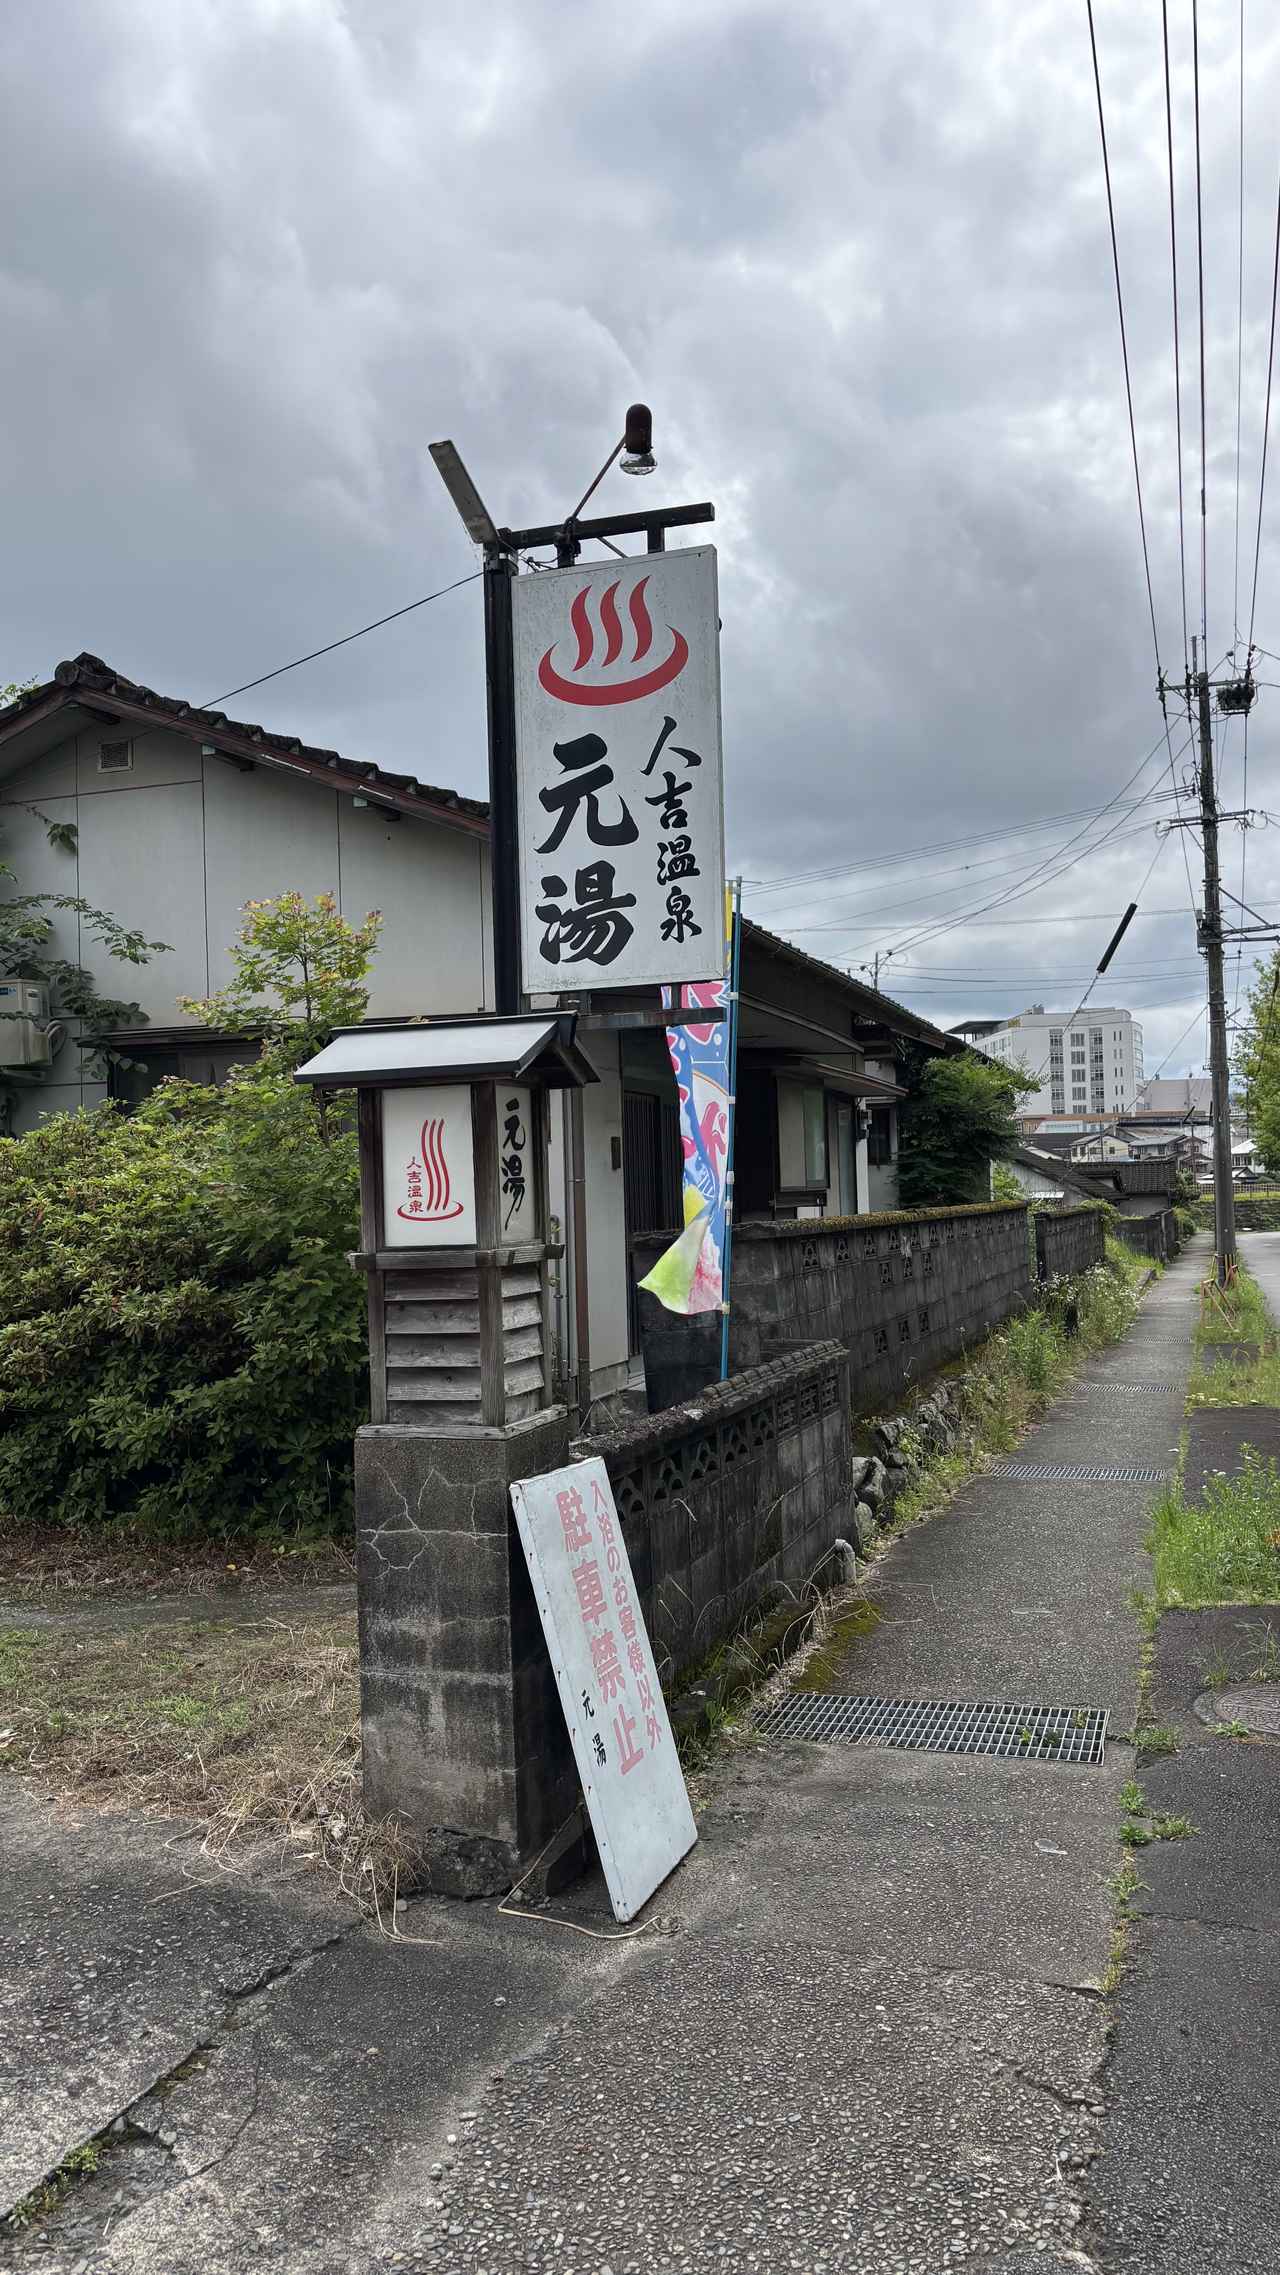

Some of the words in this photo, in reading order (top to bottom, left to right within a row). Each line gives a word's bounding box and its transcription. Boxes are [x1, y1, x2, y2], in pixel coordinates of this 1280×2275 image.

[533, 732, 640, 967] 元湯
[640, 715, 703, 944] 人吉温泉
[406, 1156, 424, 1213] 人吉温泉
[502, 1097, 526, 1231] 元湯
[556, 1486, 645, 1776] 駐車禁止
[581, 1689, 607, 1767] 元湯
